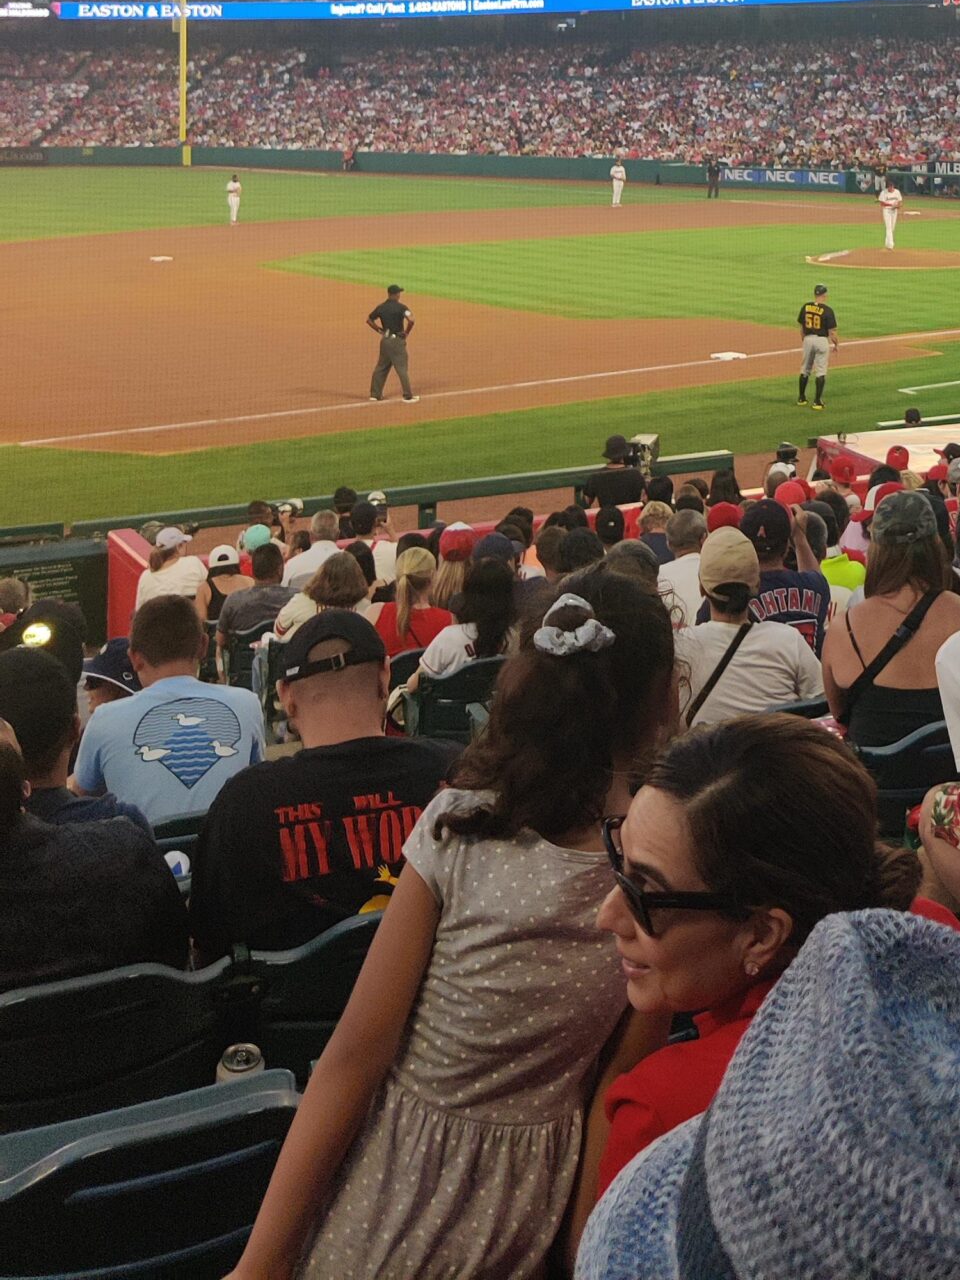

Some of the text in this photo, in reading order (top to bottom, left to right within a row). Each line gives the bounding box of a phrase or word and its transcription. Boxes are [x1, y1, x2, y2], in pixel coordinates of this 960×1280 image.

[78, 5, 222, 17] EASTON & EASTON
[724, 169, 753, 181] NEC
[765, 170, 795, 183] NEC
[808, 172, 839, 185] NEC
[274, 790, 403, 824] THIS WILL
[279, 821, 333, 883] MY
